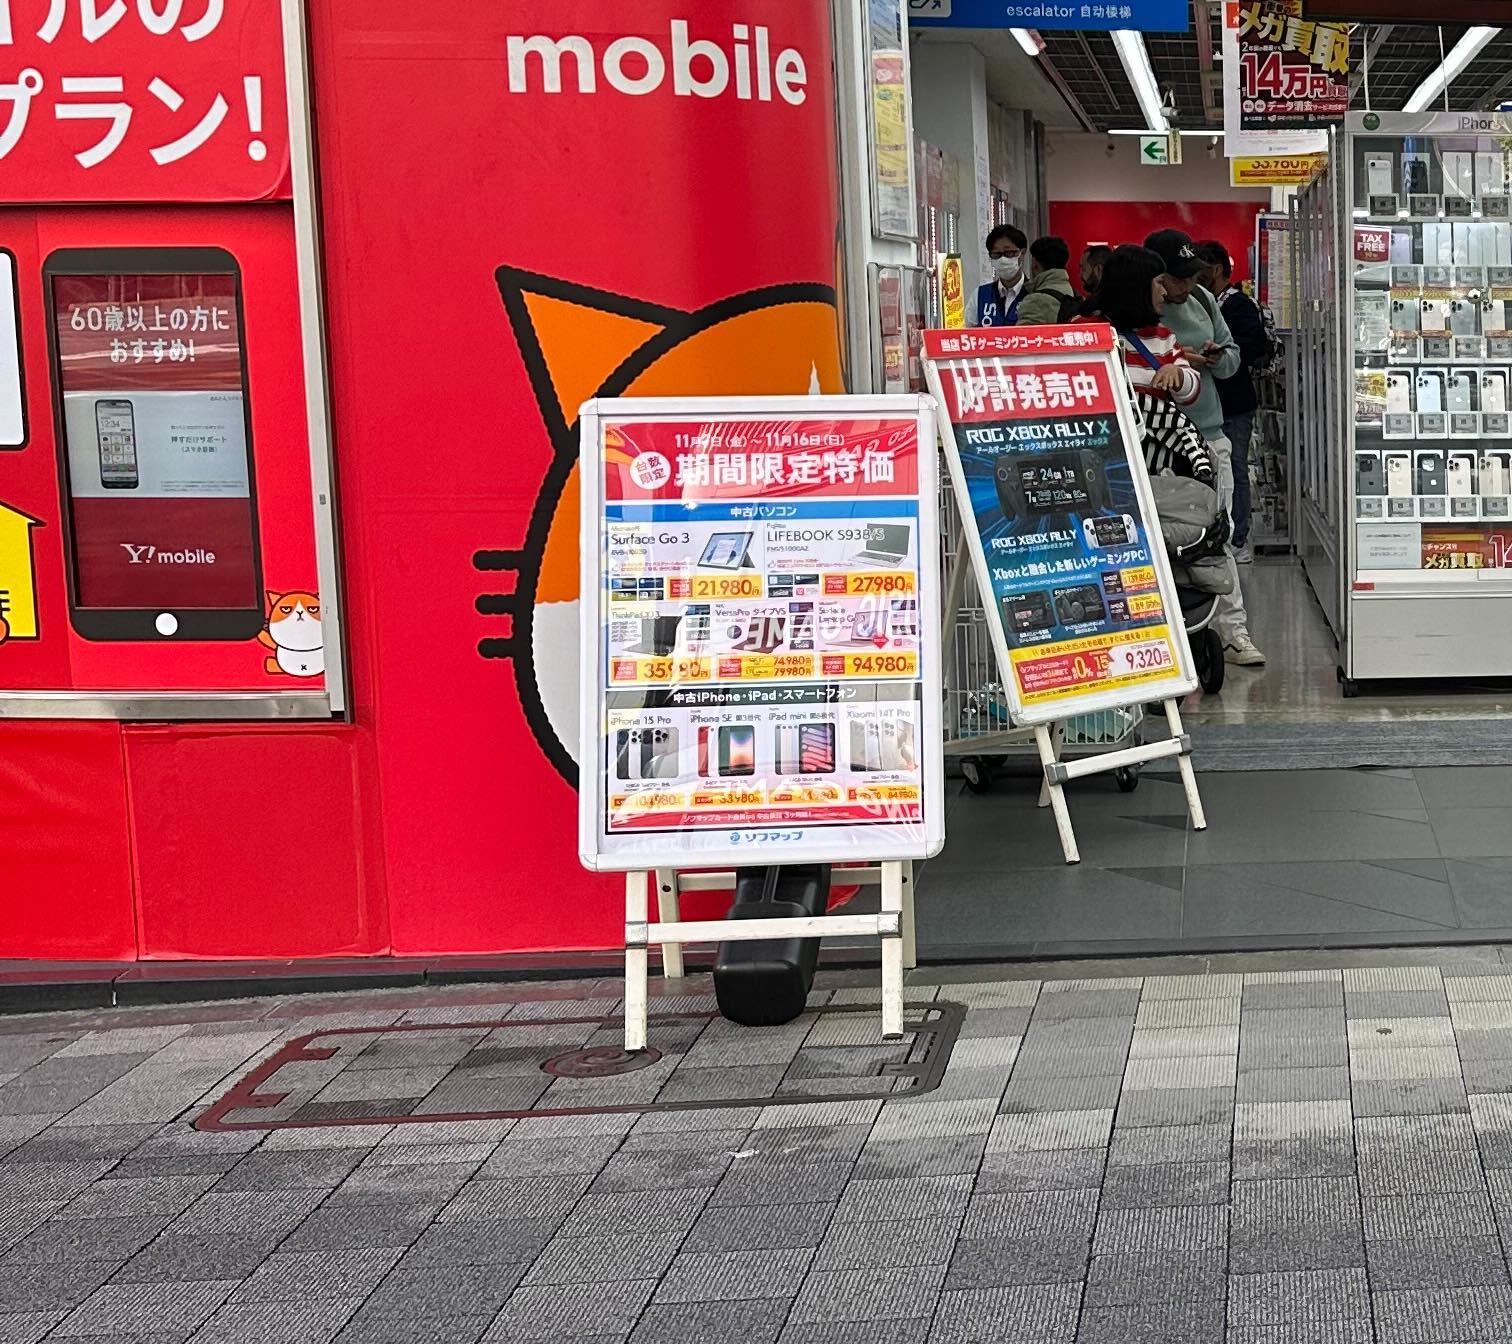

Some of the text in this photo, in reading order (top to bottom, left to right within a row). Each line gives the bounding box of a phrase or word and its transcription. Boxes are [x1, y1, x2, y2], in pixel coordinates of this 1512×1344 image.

[1007, 4, 1075, 18] escalator
[508, 19, 808, 105] mobile
[1360, 233, 1383, 243] TAX
[1357, 242, 1386, 253] FREE
[70, 306, 230, 333] 60歳以上の方に
[957, 369, 1100, 416] 好評発売中
[966, 419, 1111, 445] ROG XBOX ALLY X
[674, 451, 894, 486] 期間限定特価
[730, 505, 797, 518] 中古パソコン
[611, 532, 690, 545] Surface Go 3
[767, 529, 834, 542] LIFEBOOK
[991, 529, 1077, 549] ROG XBOX ALLY
[158, 549, 216, 564] mobile
[657, 715, 671, 724] Pro
[690, 714, 720, 723] iPhone
[722, 714, 732, 722] SE
[769, 711, 807, 721] iPad mini
